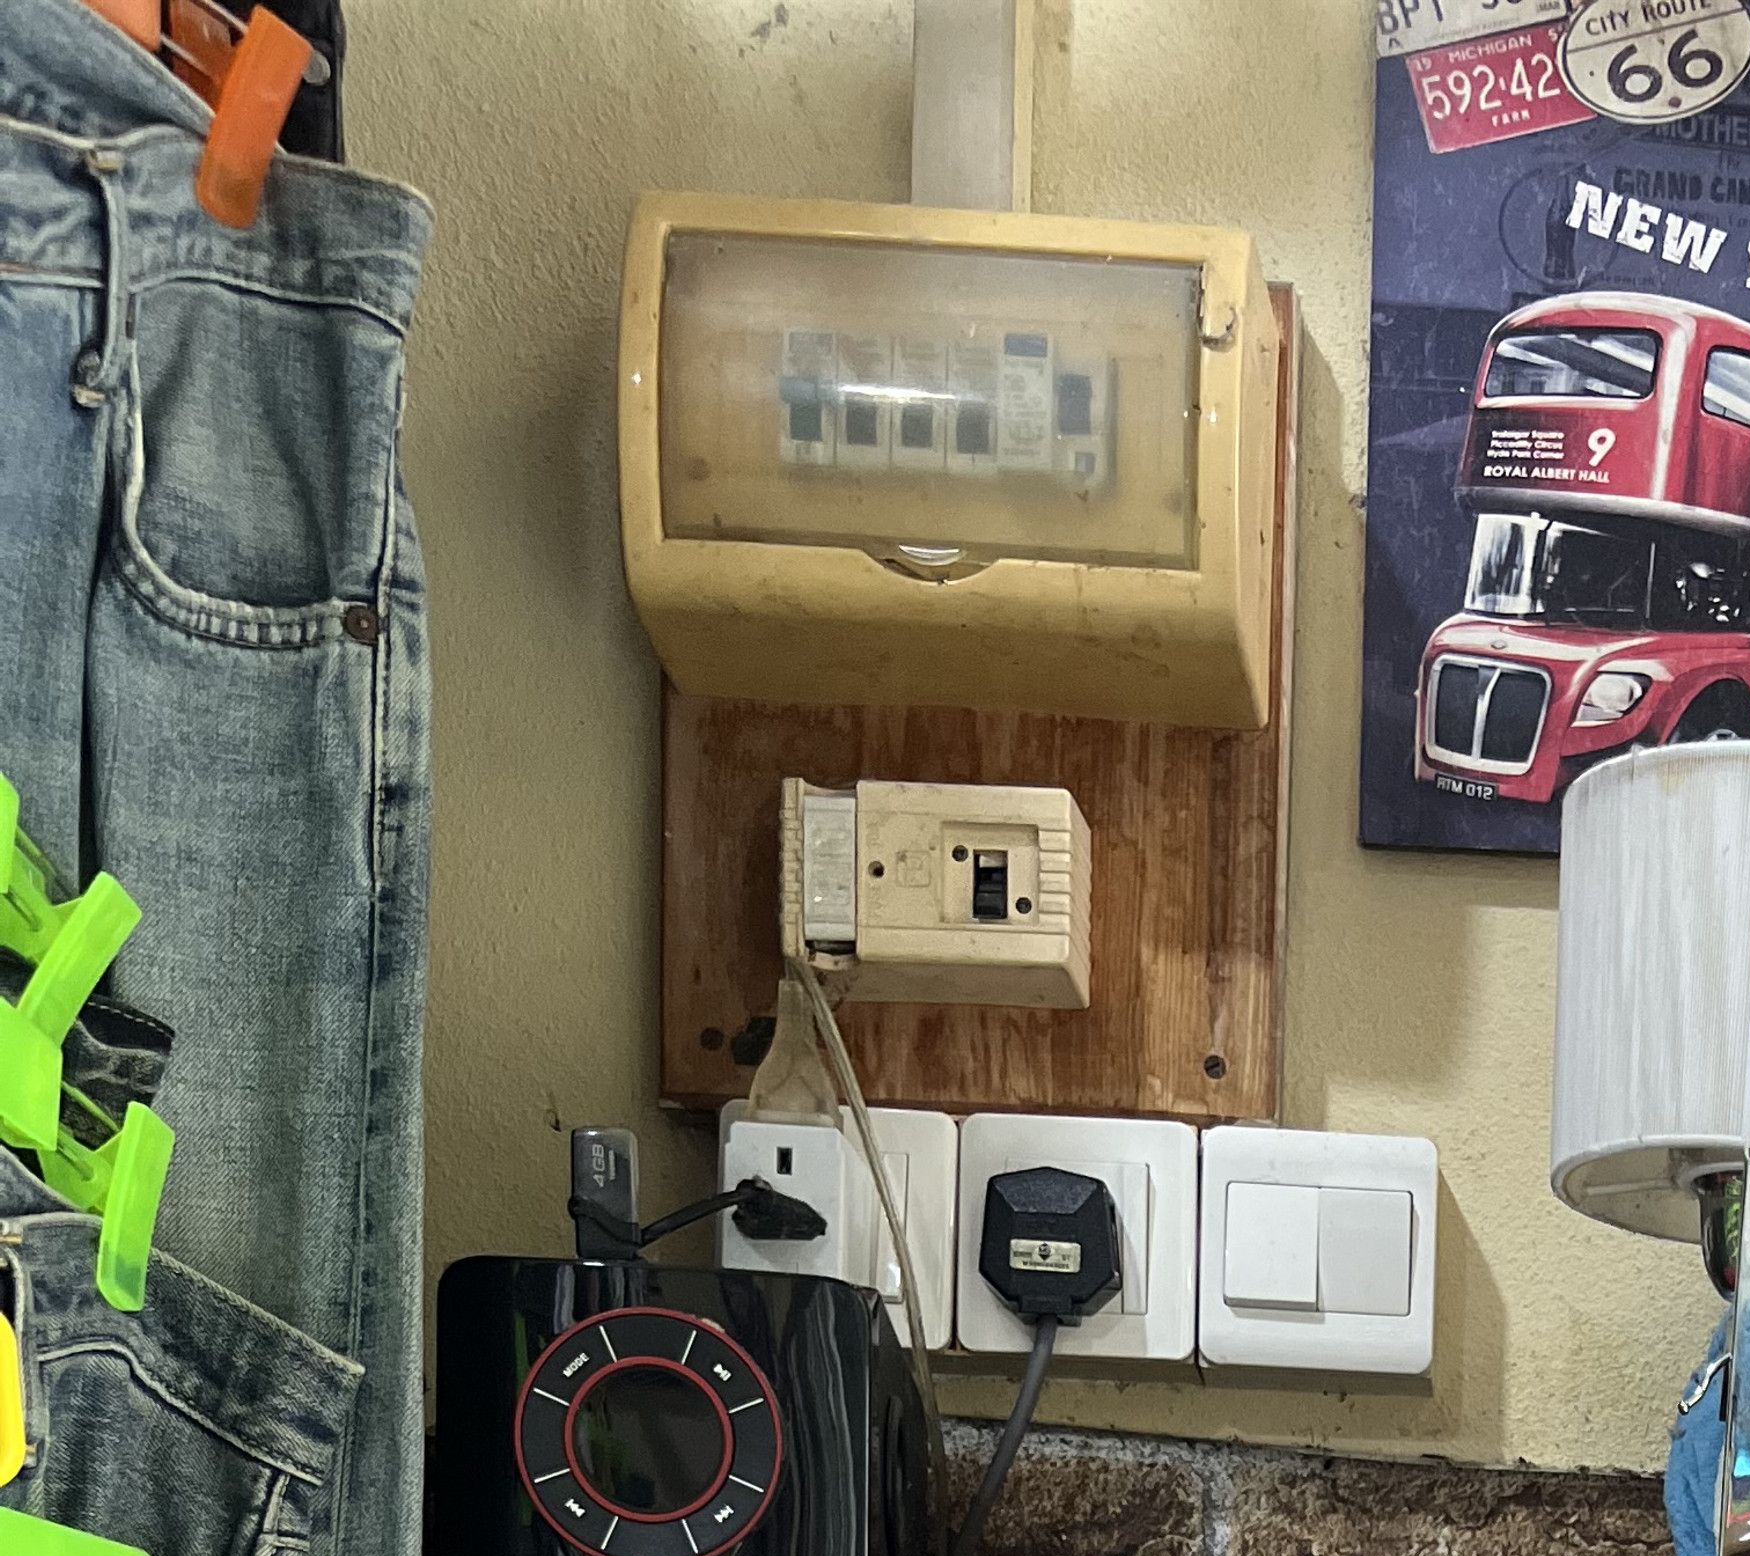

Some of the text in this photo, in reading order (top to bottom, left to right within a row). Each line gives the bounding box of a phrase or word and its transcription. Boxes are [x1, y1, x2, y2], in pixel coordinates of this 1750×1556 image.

[1585, 12, 1630, 35] CITY
[1449, 34, 1533, 63] MICHIGAN
[1607, 28, 1723, 102] 66
[1613, 167, 1701, 200] GRAND
[1565, 180, 1727, 274] NEW
[1588, 427, 1616, 467] 9
[1483, 465, 1610, 483] ROYAL ALBERT HALL
[592, 1144, 605, 1188] 4GB
[563, 1353, 590, 1377] MODE
